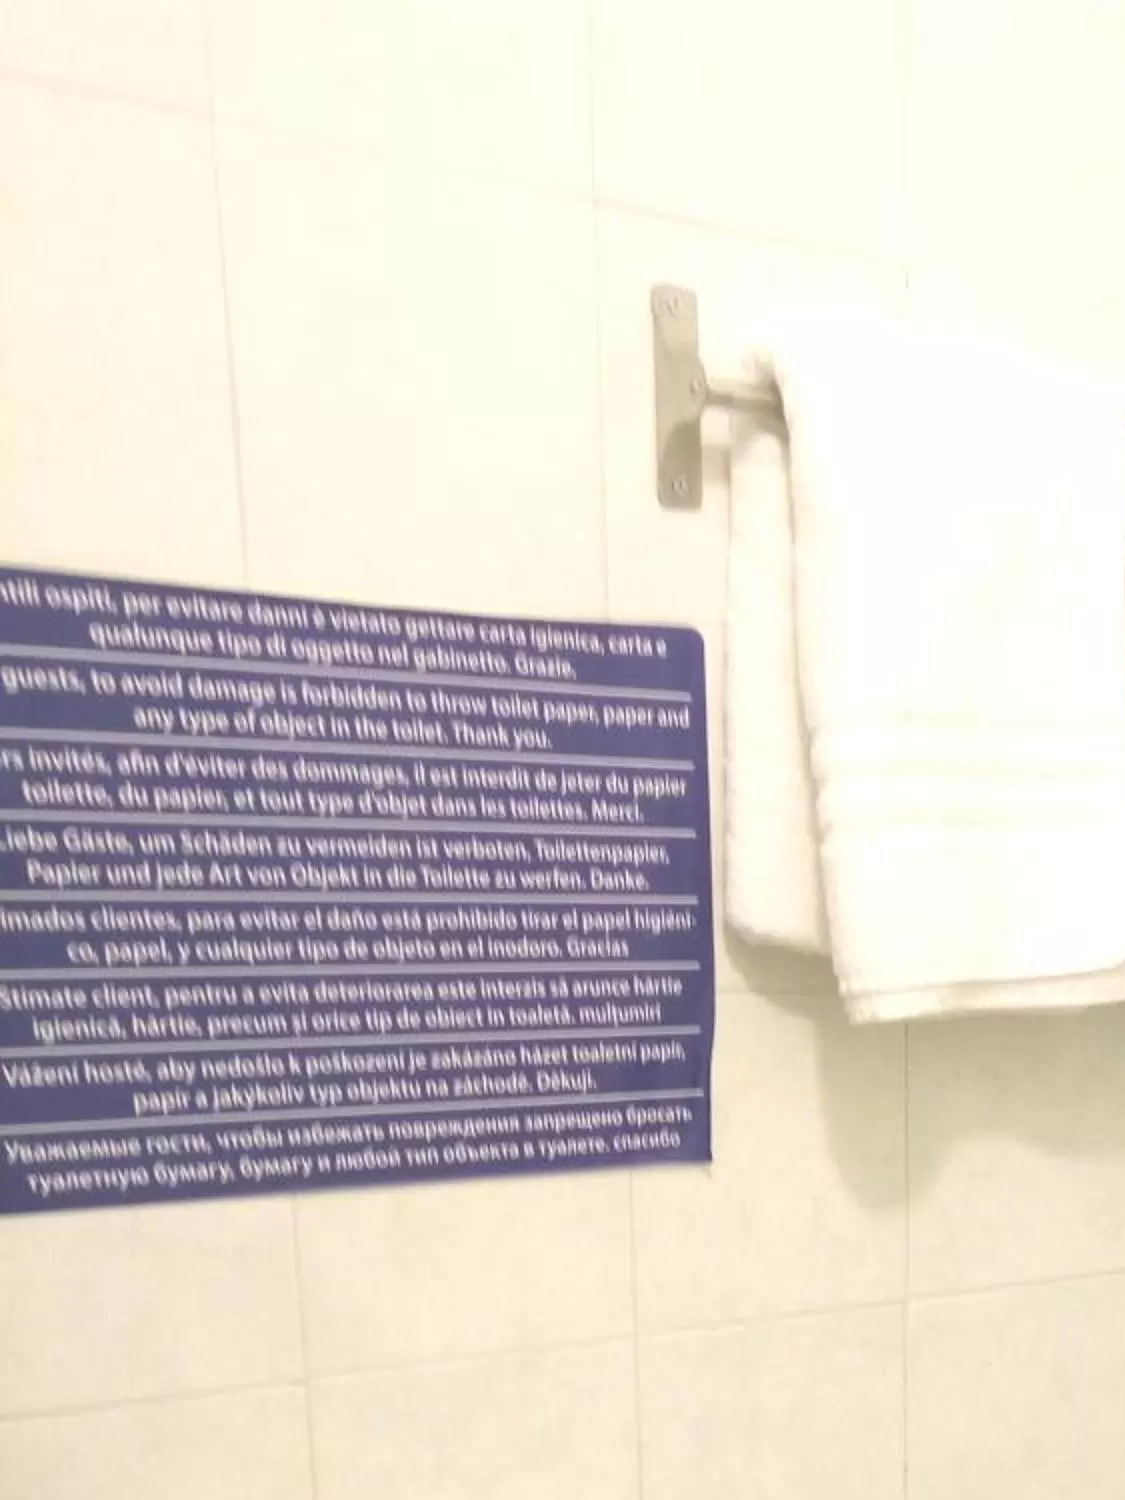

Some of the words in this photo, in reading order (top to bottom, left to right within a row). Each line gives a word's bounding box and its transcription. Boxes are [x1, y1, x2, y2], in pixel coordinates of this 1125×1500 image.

[90, 668, 116, 693] to
[120, 671, 182, 697] avoid
[187, 674, 275, 706] damage
[280, 680, 296, 705] is
[301, 680, 401, 709] forbidden
[406, 688, 426, 712] to
[430, 689, 486, 715] throw
[491, 693, 538, 719] toilet
[602, 705, 652, 729] paper
[657, 706, 689, 728] and
[133, 707, 173, 733] any
[179, 707, 228, 736] type
[233, 707, 255, 733] of
[259, 710, 324, 740] object
[330, 715, 349, 738] in
[354, 715, 388, 739] the
[452, 720, 508, 746] Thank
